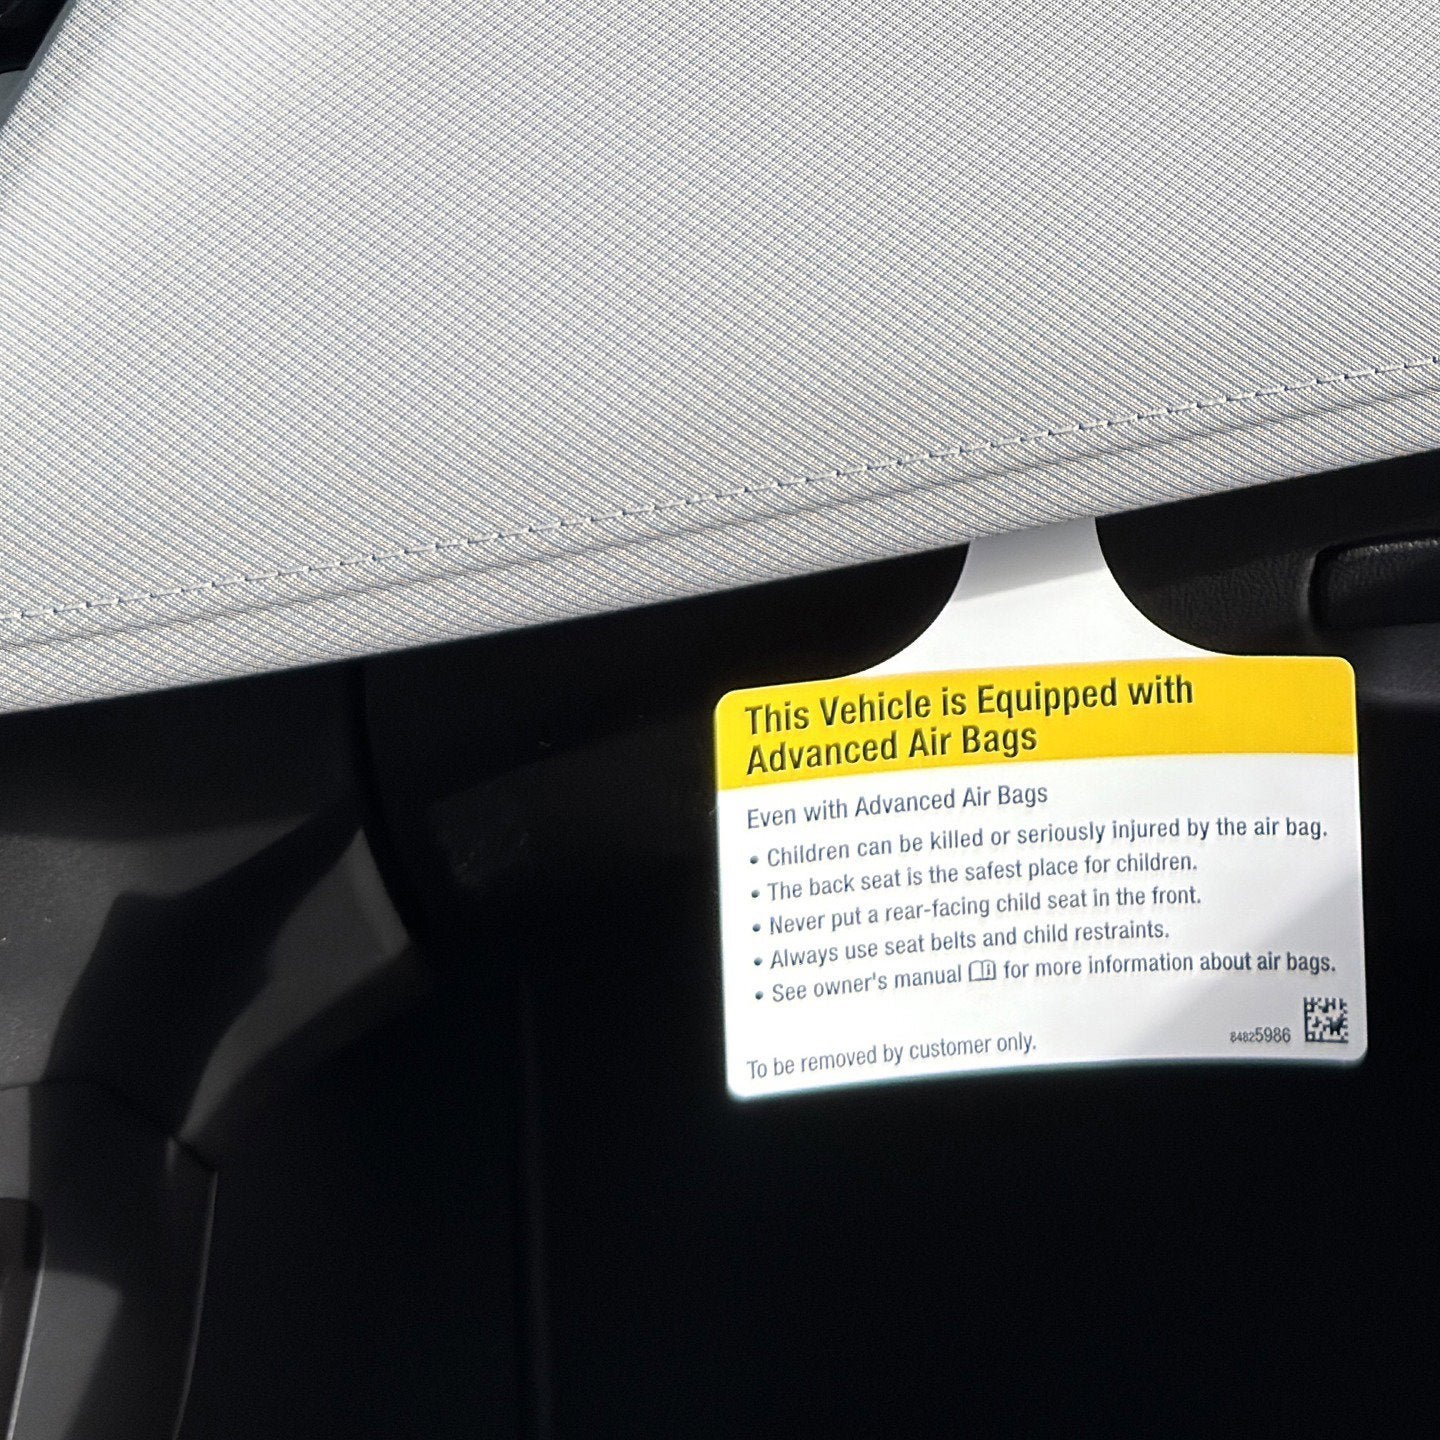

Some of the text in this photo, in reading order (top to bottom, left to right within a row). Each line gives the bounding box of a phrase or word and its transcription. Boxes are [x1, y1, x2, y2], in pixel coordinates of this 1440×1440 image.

[745, 675, 1192, 735] This Vehicle is Equipped with
[747, 726, 1036, 775] Advanced Air Bags
[748, 785, 1047, 829] Even with Advanced Air Bags
[768, 817, 1327, 867] Children can be killed or seriously injured by the air bag.
[767, 852, 1197, 901] The back seat is the safest place for children.
[770, 886, 1200, 935] Never put a rear-facing child seat in the front.
[770, 920, 1169, 969] Always use seat belts and child restraints.
[773, 951, 1335, 1002] See owner's manual for more information about air bags.
[747, 1032, 1036, 1079] To be removed by customer only.
[1229, 1026, 1292, 1044] 84825986
